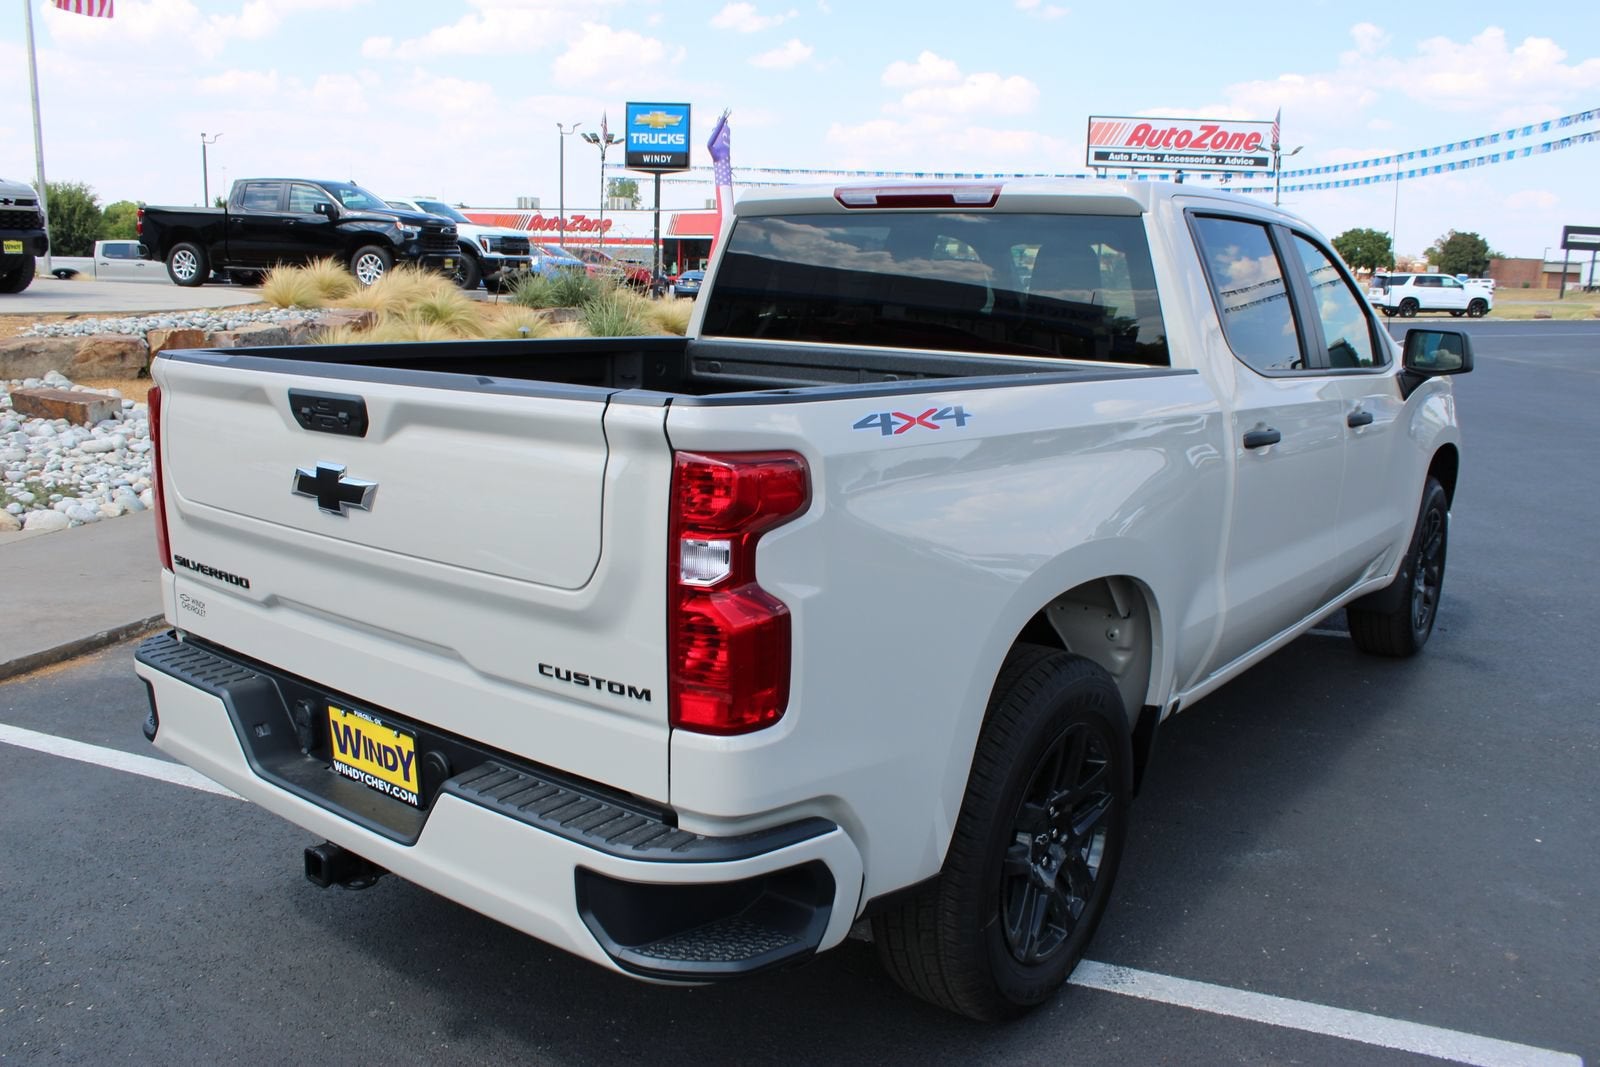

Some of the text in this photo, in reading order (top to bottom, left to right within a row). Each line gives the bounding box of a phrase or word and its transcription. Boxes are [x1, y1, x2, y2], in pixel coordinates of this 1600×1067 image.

[631, 133, 685, 145] TRUCKS
[1125, 123, 1263, 151] AutoZone
[643, 155, 672, 163] WINDY
[1108, 152, 1255, 165] Auto Parts Accessories Advice
[526, 214, 612, 233] AutoZone
[174, 554, 250, 589] SILVERADO
[181, 601, 207, 618] CHEVROLET
[538, 662, 652, 702] CUSTOM
[331, 719, 415, 783] WINDY
[333, 760, 418, 806] WINDYCHEV.COM
